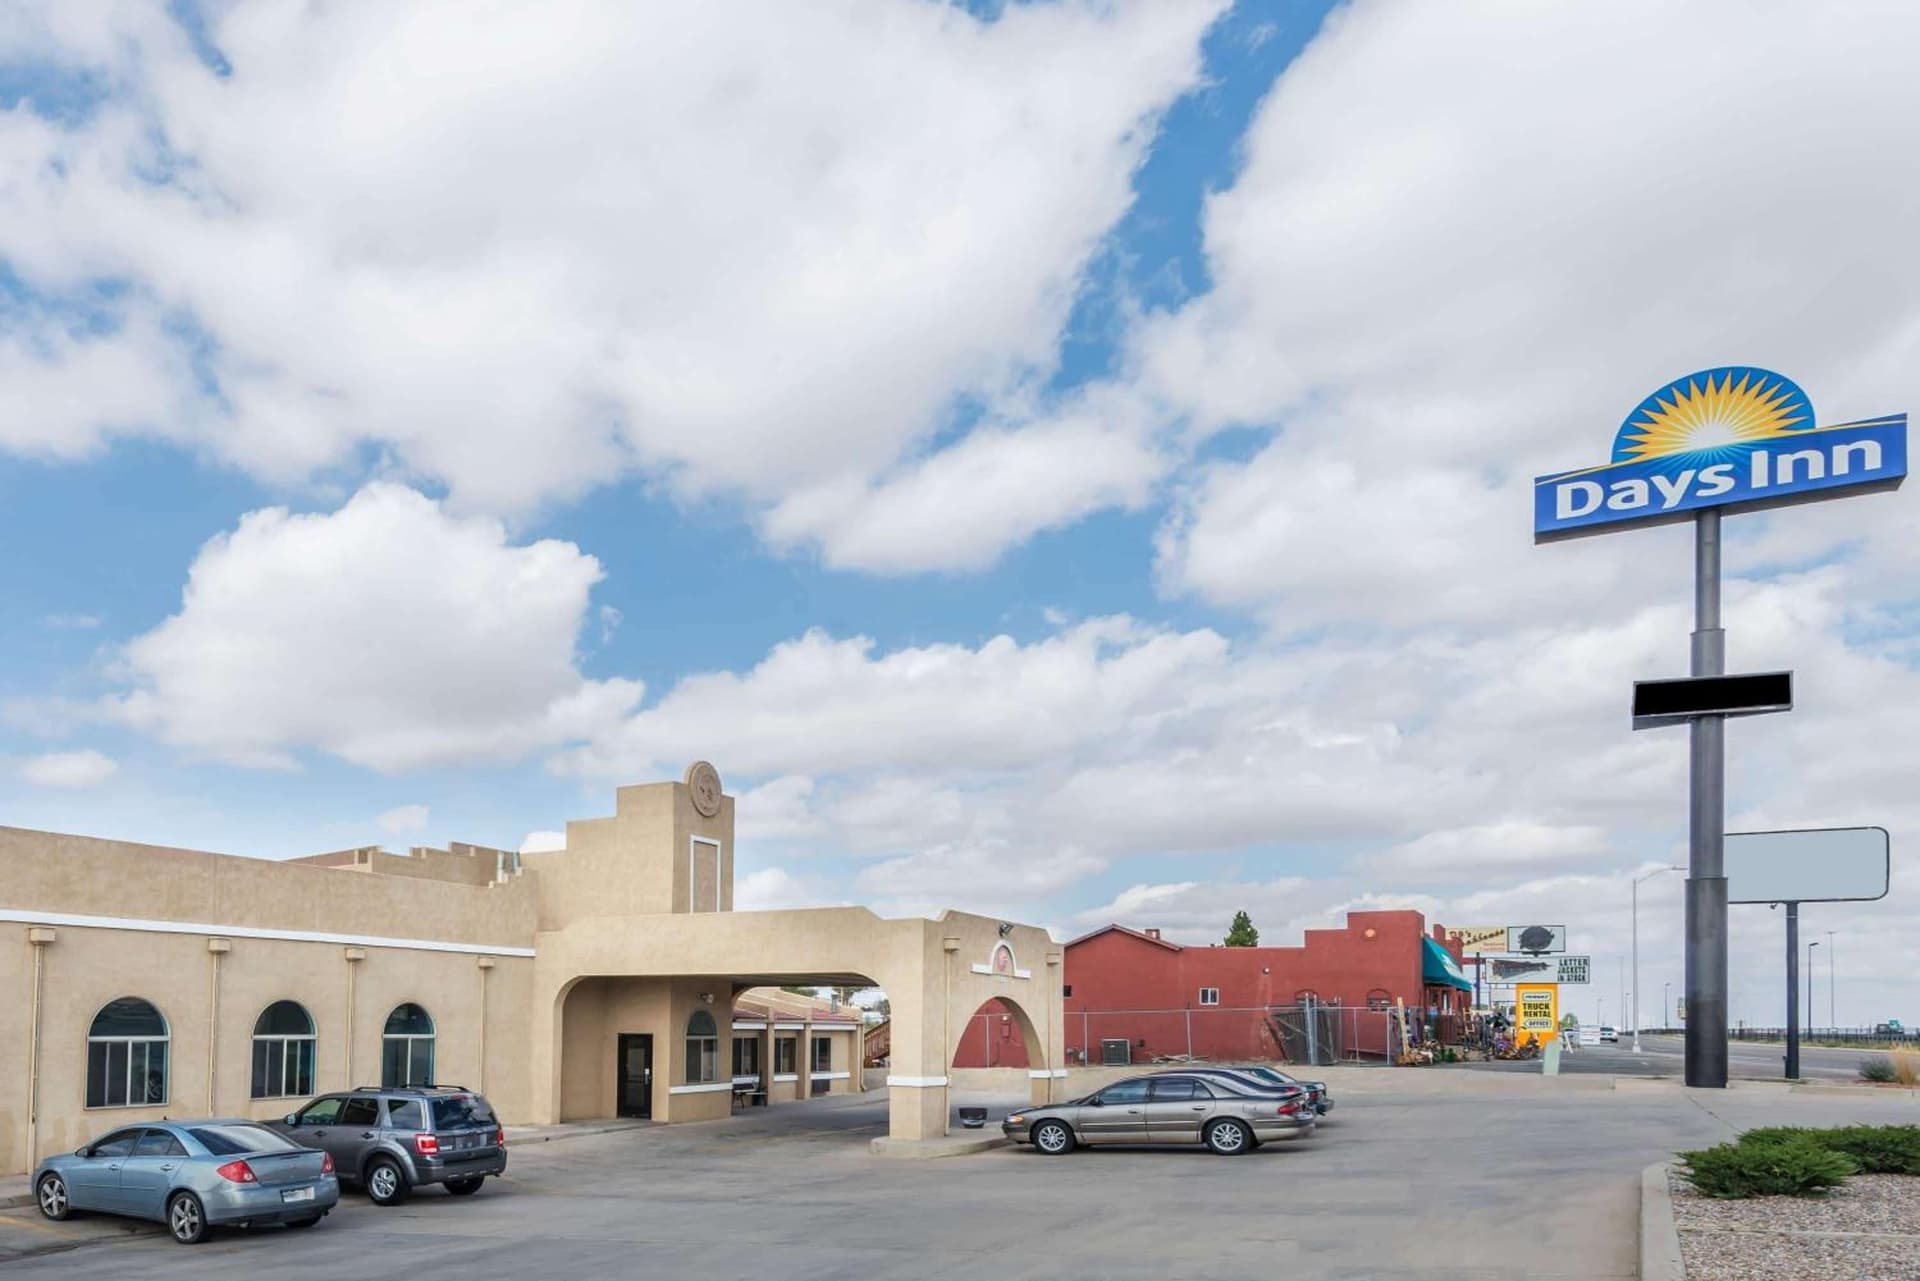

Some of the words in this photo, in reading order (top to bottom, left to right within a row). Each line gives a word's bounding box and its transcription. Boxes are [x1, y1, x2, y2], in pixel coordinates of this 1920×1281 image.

[1556, 463, 1735, 521] Days
[1751, 439, 1883, 489] Inn
[1557, 967, 1586, 975] JACKETS
